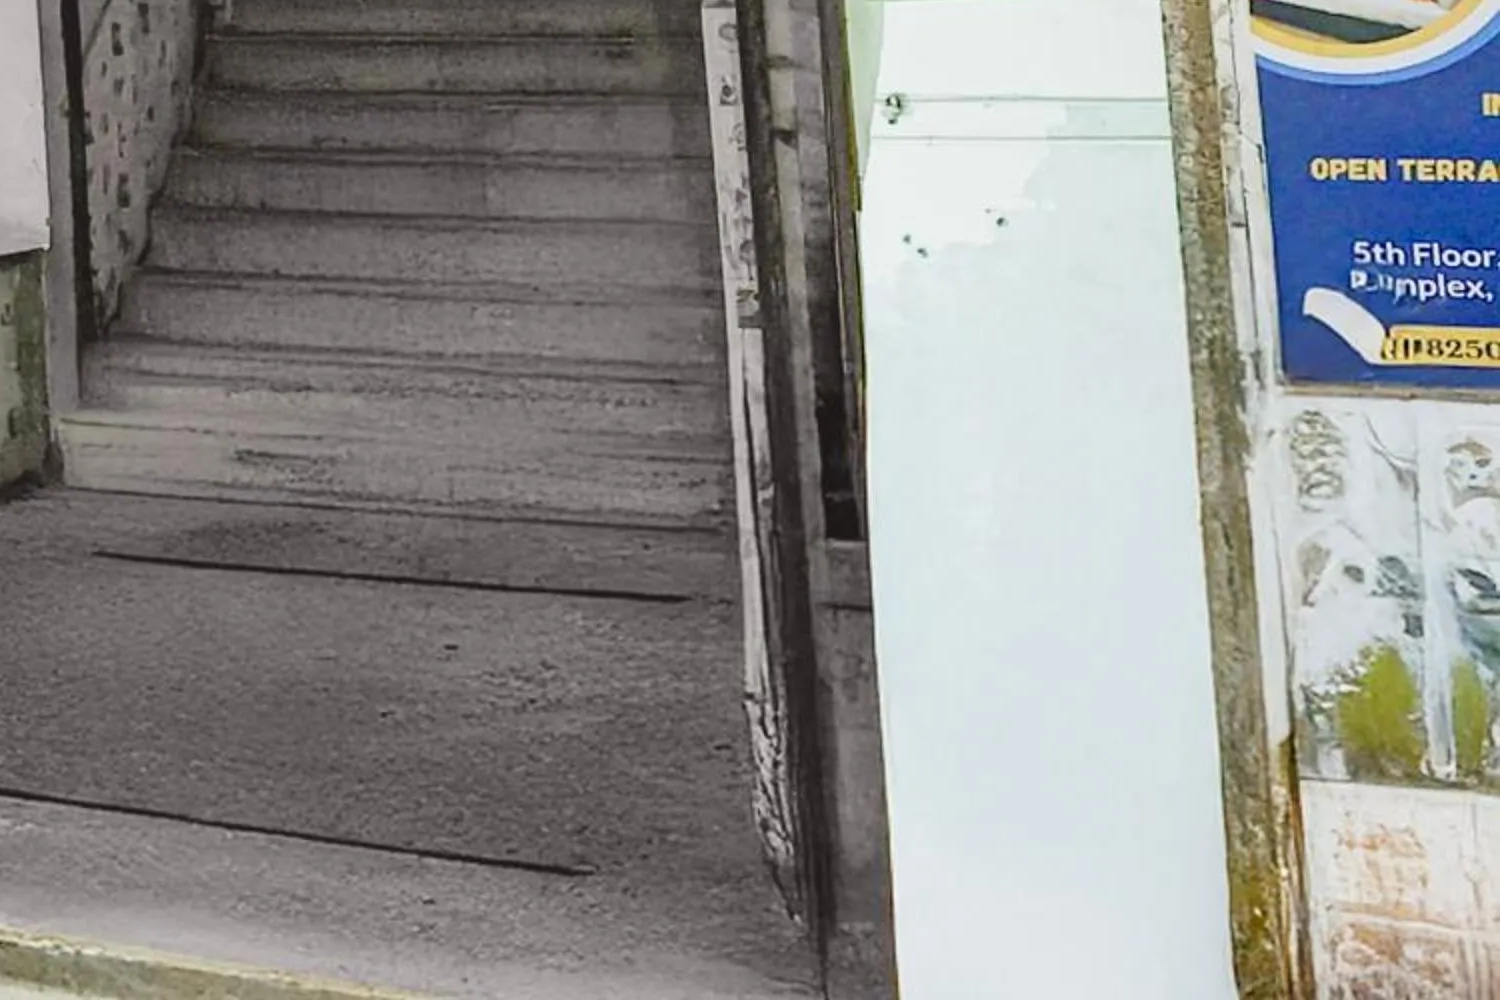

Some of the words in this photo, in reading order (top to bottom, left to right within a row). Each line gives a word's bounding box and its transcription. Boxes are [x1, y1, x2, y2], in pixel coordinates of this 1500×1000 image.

[1310, 157, 1388, 182] OPEN
[1397, 158, 1500, 183] TERRA
[1353, 240, 1405, 267] 5th
